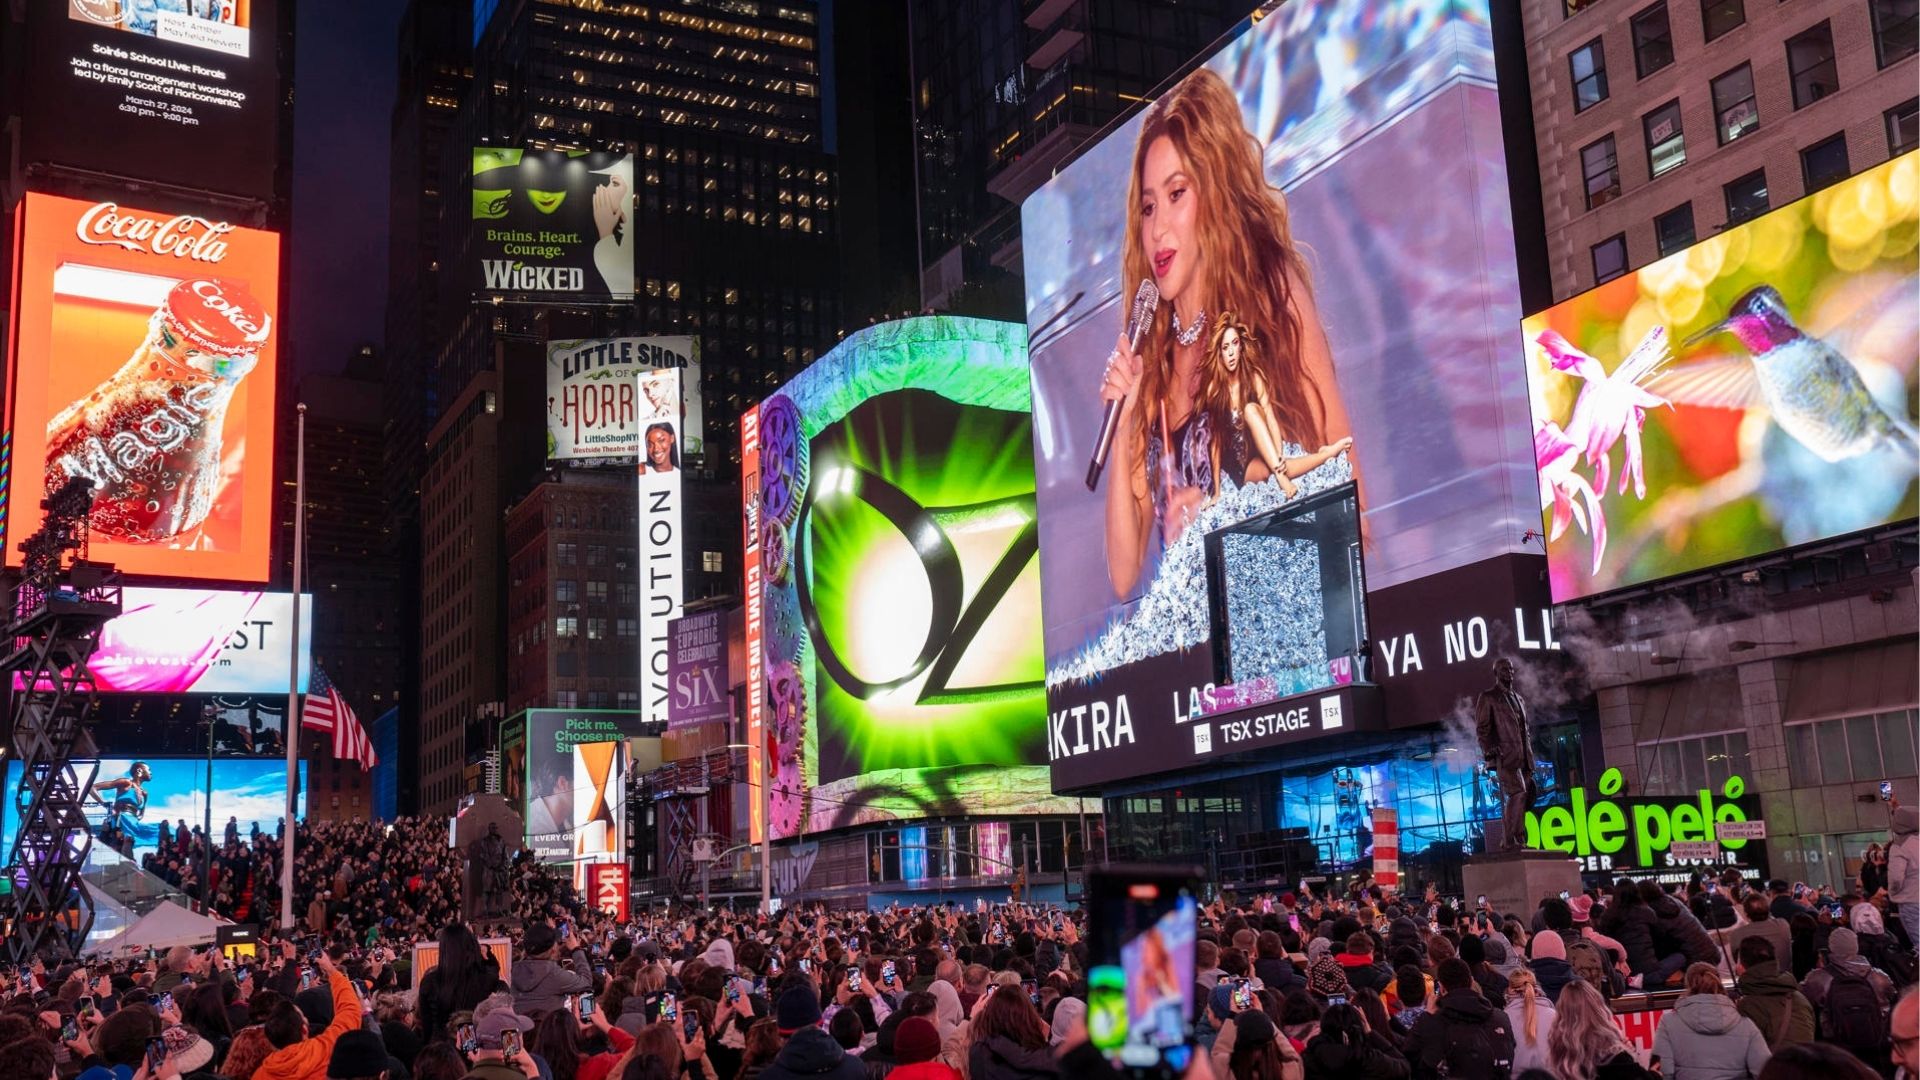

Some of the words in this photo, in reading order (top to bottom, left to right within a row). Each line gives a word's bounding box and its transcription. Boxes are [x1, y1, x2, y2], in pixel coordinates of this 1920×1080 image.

[92, 43, 129, 59] Soirée
[129, 51, 166, 67] School
[167, 59, 191, 73] Live:
[192, 65, 226, 80] Florals
[70, 57, 92, 69] Join
[93, 62, 101, 71] a
[102, 63, 128, 76] floral
[129, 69, 196, 91] arrangement
[197, 84, 246, 101] workshop
[74, 67, 91, 79] led
[92, 71, 106, 83] by
[107, 74, 134, 88] Emily
[135, 81, 162, 93] Scott
[163, 86, 174, 95] of
[118, 103, 137, 114] 6:30
[138, 108, 155, 118] pm
[163, 112, 182, 123] 9:00
[182, 117, 199, 126] pm
[125, 95, 155, 107] March
[171, 104, 193, 115] 2024
[76, 201, 237, 264] Coca-Cola
[486, 229, 536, 242] Brains.
[539, 231, 582, 243] Heart.
[503, 244, 565, 259] Courage.
[191, 280, 273, 342] Coke
[563, 342, 632, 381] LITTLE
[637, 343, 688, 369] SHOP
[615, 369, 629, 378] OF
[562, 383, 637, 444] HORR
[58, 382, 217, 489] Magic
[584, 433, 638, 443] LittleShopNY
[744, 412, 758, 456] ATE
[573, 446, 601, 454] Westside
[650, 489, 673, 721] VOLUTION
[748, 564, 760, 635] COME
[677, 612, 718, 633] BROADWAY'S
[749, 639, 761, 728] INSIDE!
[1173, 682, 1217, 724] LAS
[1379, 632, 1423, 677] YA
[1443, 616, 1489, 665] NO
[565, 719, 592, 730] Pick
[594, 721, 618, 730] me.
[1220, 718, 1252, 743] TSX
[1255, 707, 1311, 736] STAGE
[1324, 707, 1339, 718] TSX
[555, 731, 603, 741] Choose
[556, 743, 574, 753] Str
[1196, 733, 1209, 744] TSX
[535, 834, 560, 842] EVERY
[562, 833, 576, 841] GR
[598, 867, 624, 919] tkts
